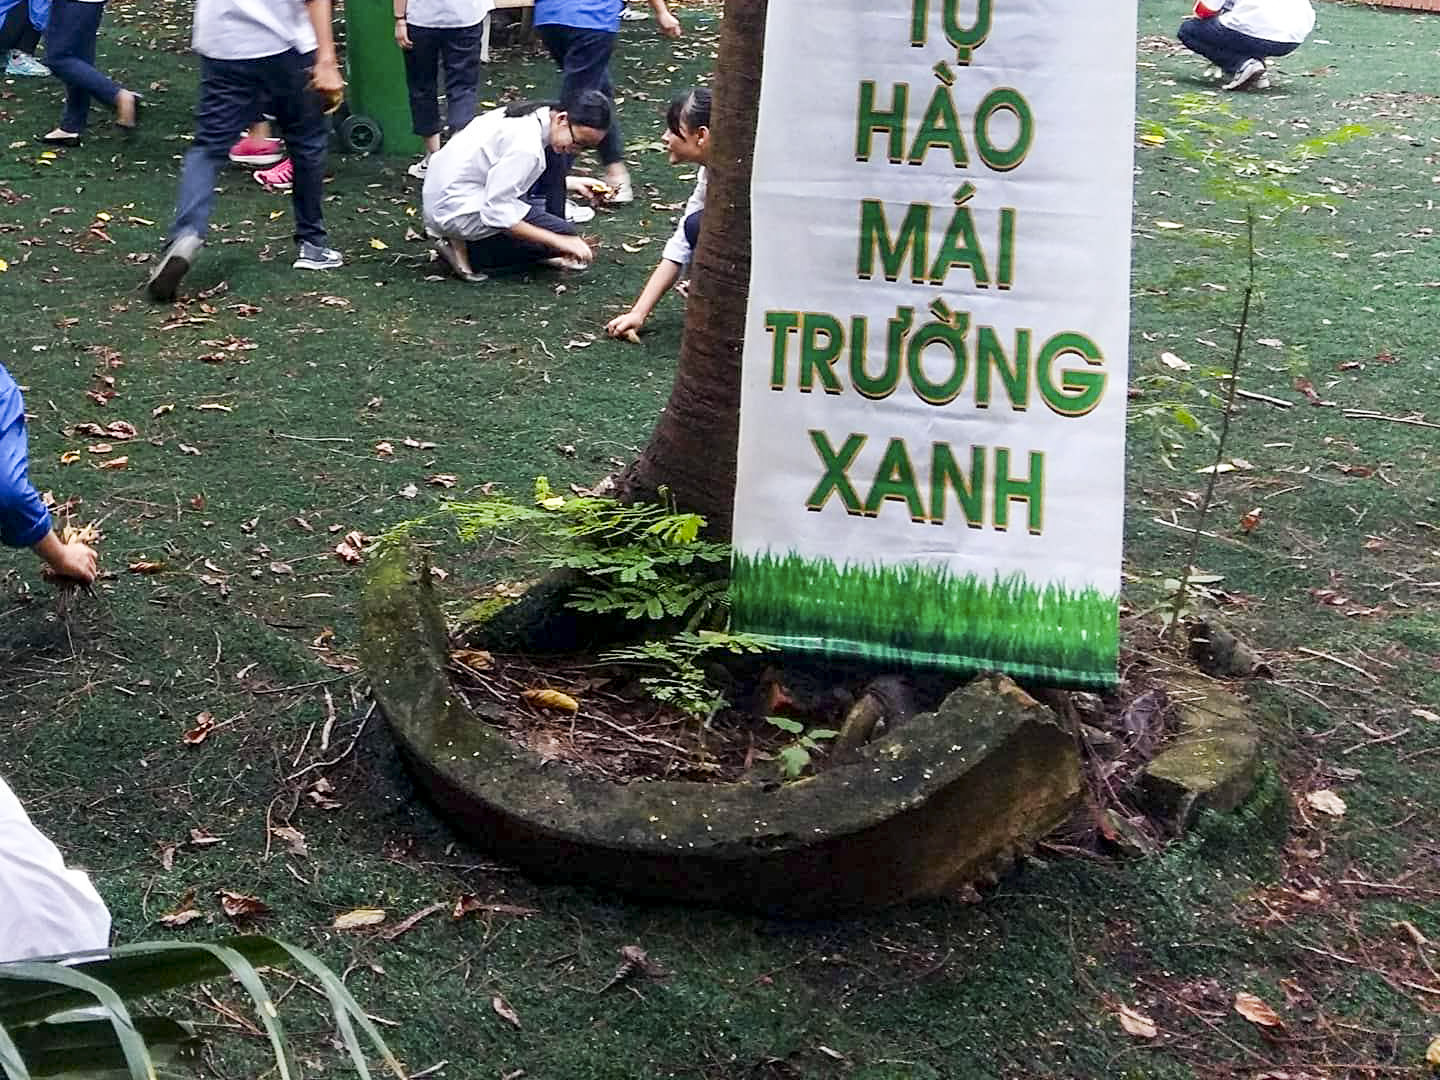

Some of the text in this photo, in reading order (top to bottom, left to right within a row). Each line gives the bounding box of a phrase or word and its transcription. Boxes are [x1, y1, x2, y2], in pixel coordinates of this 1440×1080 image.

[855, 59, 1035, 172] HÀO
[856, 180, 1017, 291] MÁI
[764, 296, 1108, 418] TRƯỜNG
[804, 428, 1047, 536] XANH
